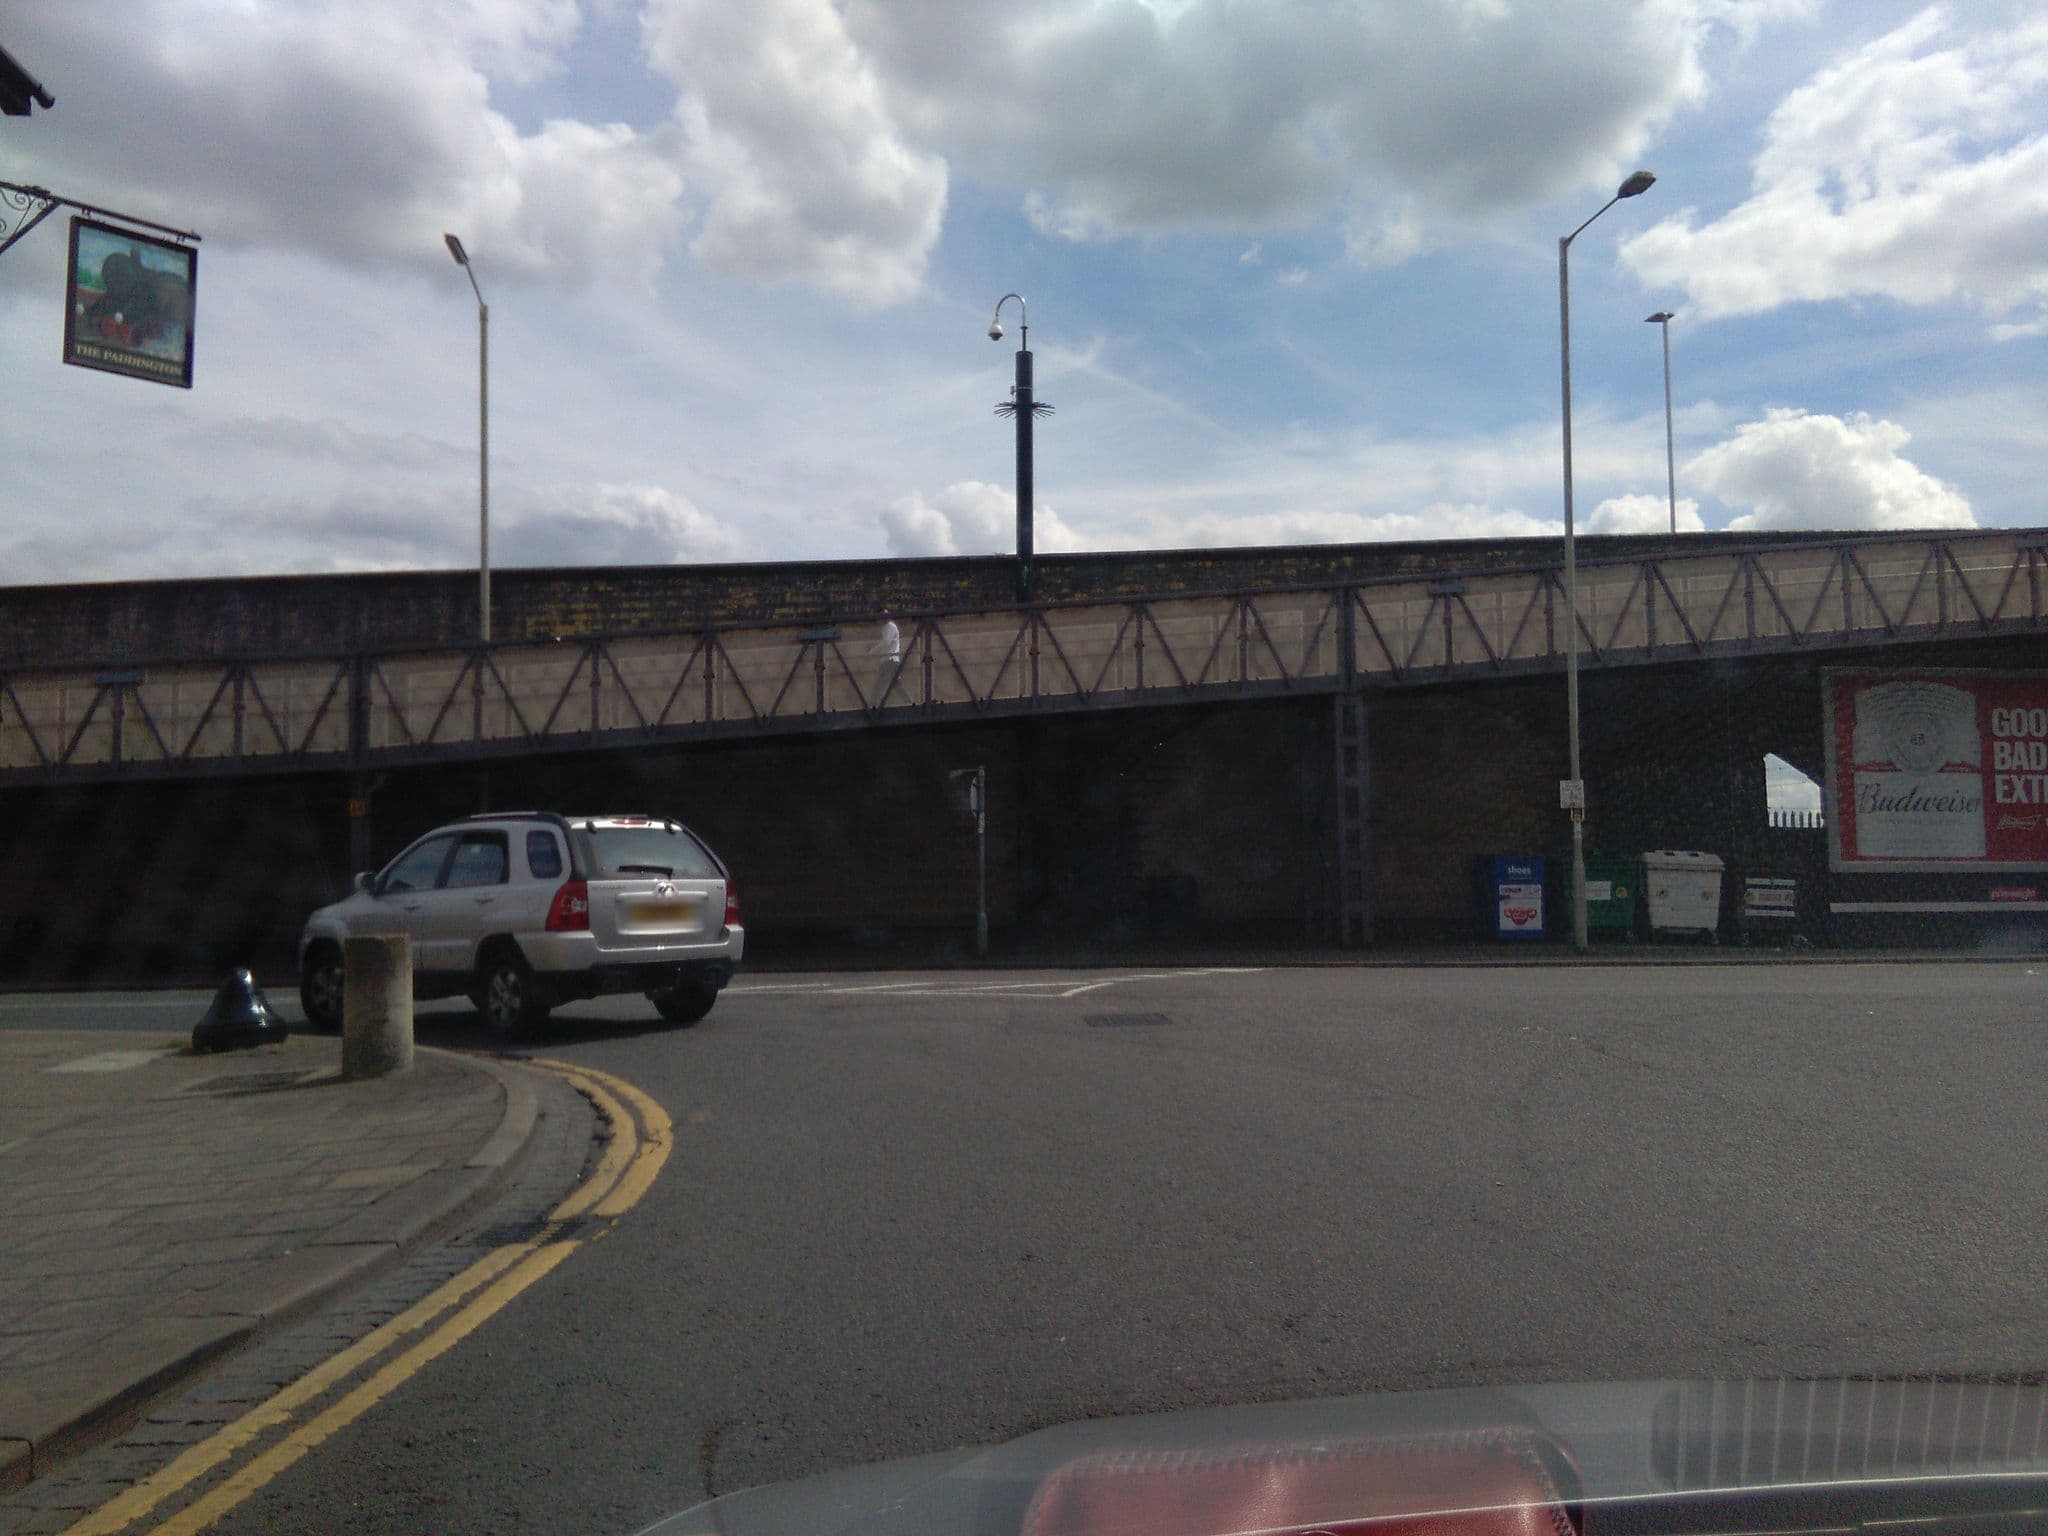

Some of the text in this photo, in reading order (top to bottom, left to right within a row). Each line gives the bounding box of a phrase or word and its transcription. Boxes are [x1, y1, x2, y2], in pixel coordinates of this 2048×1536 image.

[76, 344, 183, 375] THE PADDINGTON
[1993, 741, 2048, 770] BAD
[1856, 783, 1981, 814] Budweiser
[1507, 865, 1531, 875] shoes
